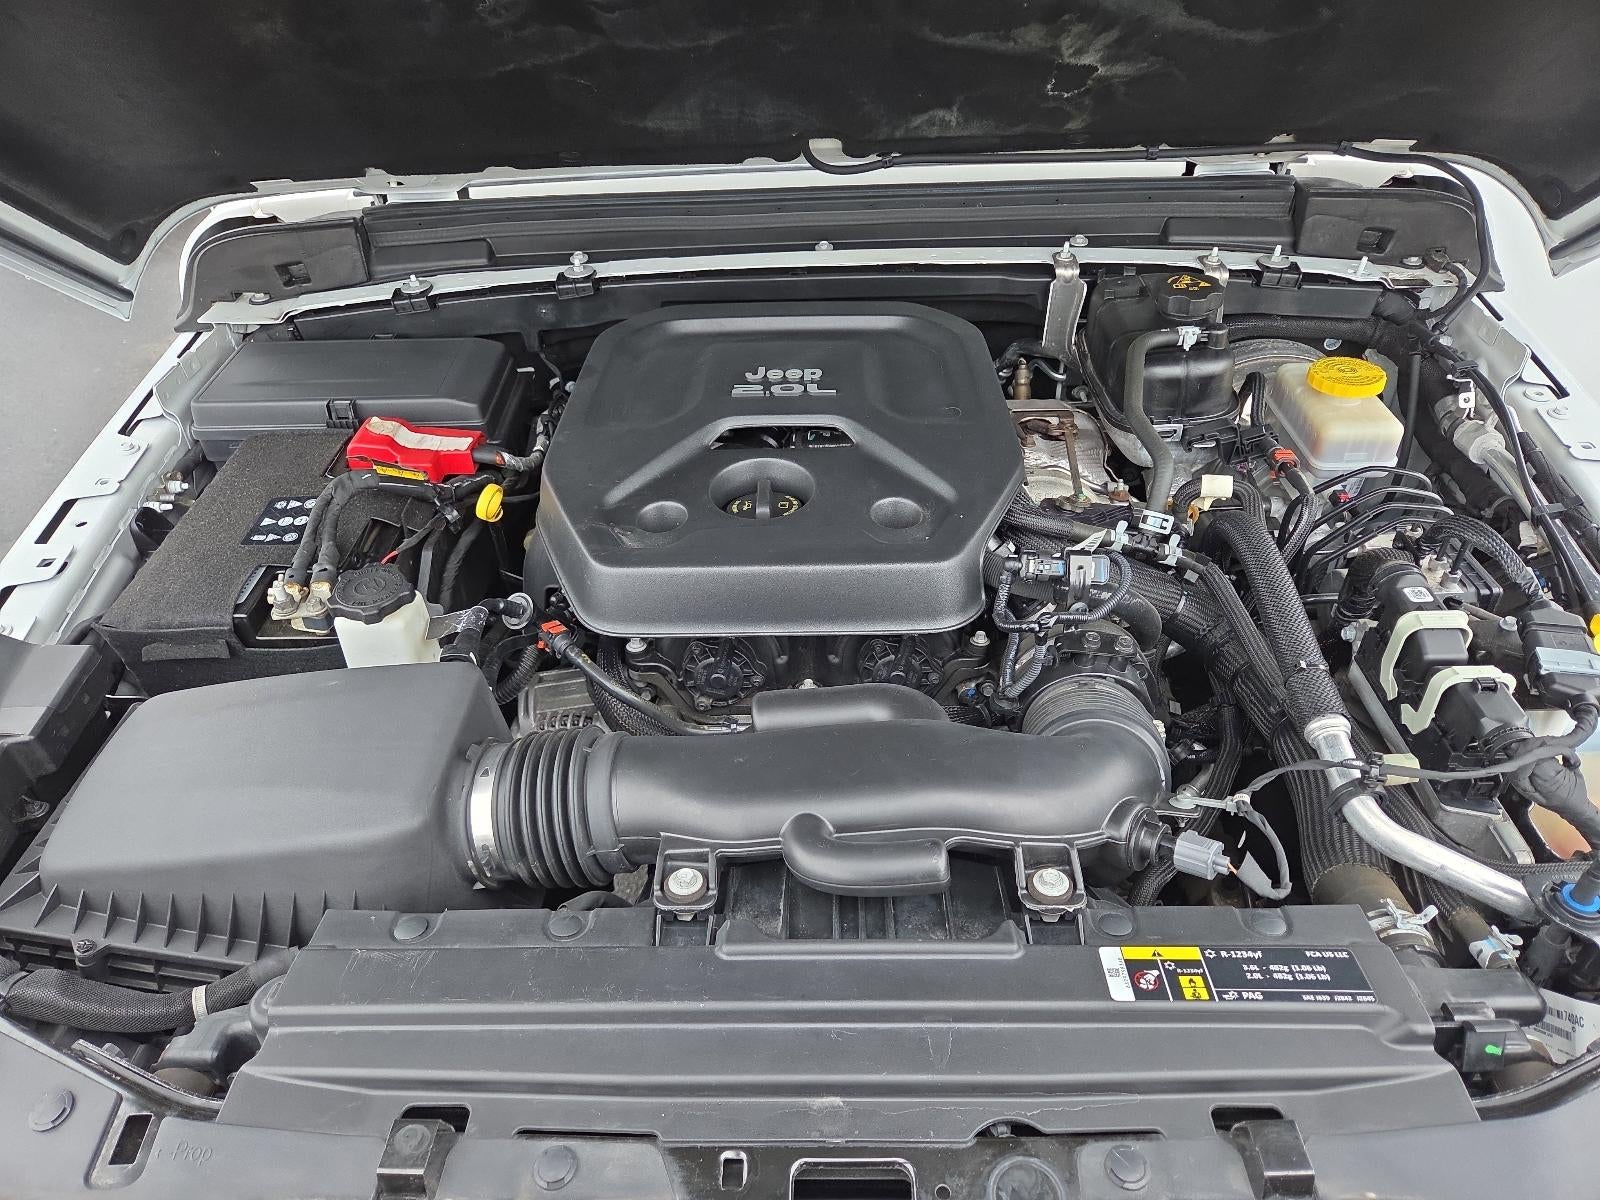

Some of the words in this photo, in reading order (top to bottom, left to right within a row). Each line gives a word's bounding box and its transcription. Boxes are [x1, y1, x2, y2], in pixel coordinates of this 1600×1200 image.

[745, 366, 823, 383] Jeep
[731, 383, 837, 398] 2.0L
[1220, 950, 1262, 960] R-1234yf
[1333, 951, 1350, 959] LLC
[1245, 972, 1264, 980] 2.0L
[1241, 991, 1264, 1000] PAG
[172, 1141, 213, 1167] Prop
